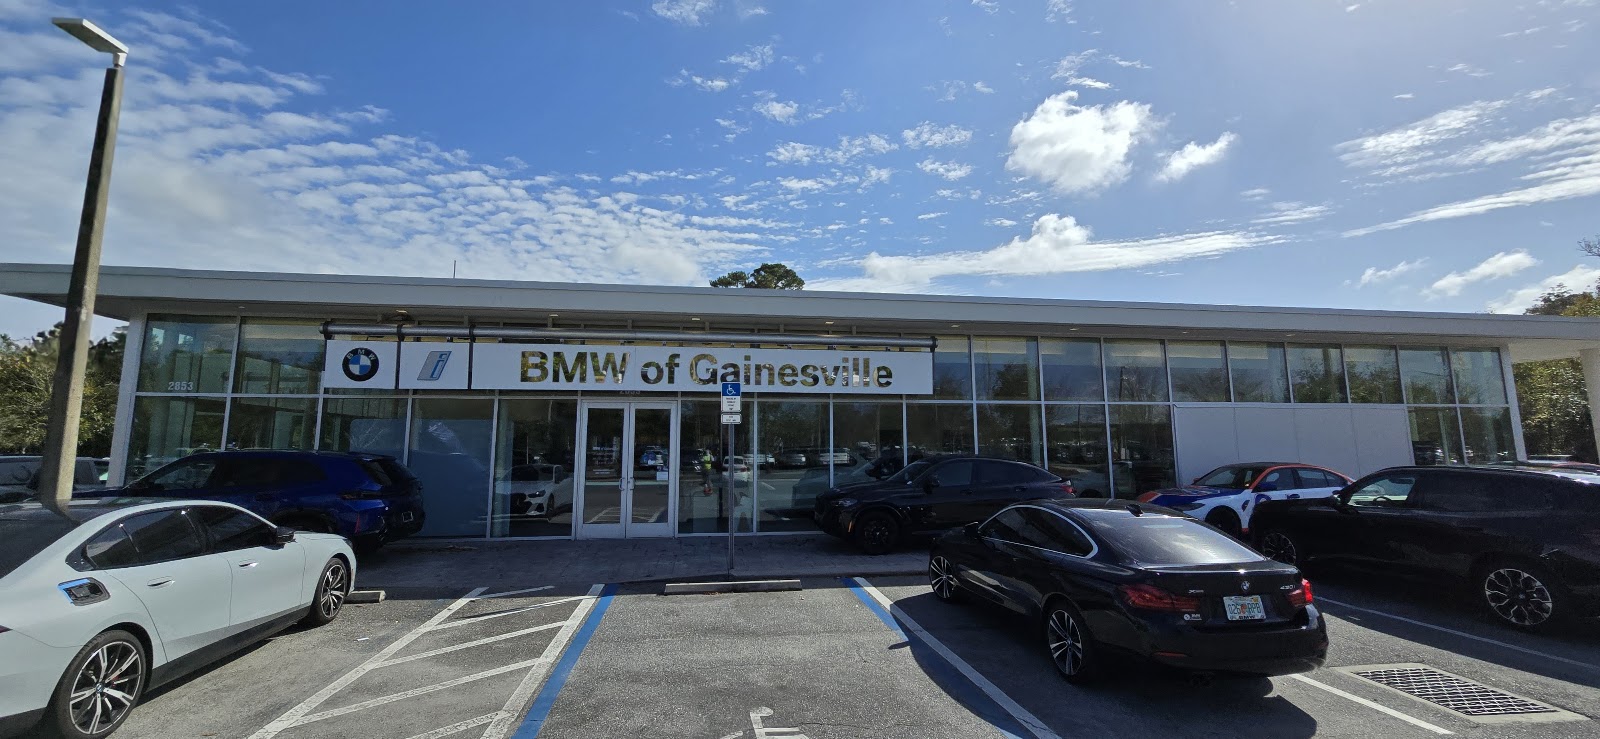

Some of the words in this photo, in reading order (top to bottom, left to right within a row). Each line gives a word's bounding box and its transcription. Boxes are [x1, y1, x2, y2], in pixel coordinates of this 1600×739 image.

[346, 349, 377, 361] BMW
[520, 350, 631, 384] BMW
[640, 353, 681, 385] of
[689, 353, 893, 388] Gainesville
[168, 381, 194, 391] 2853
